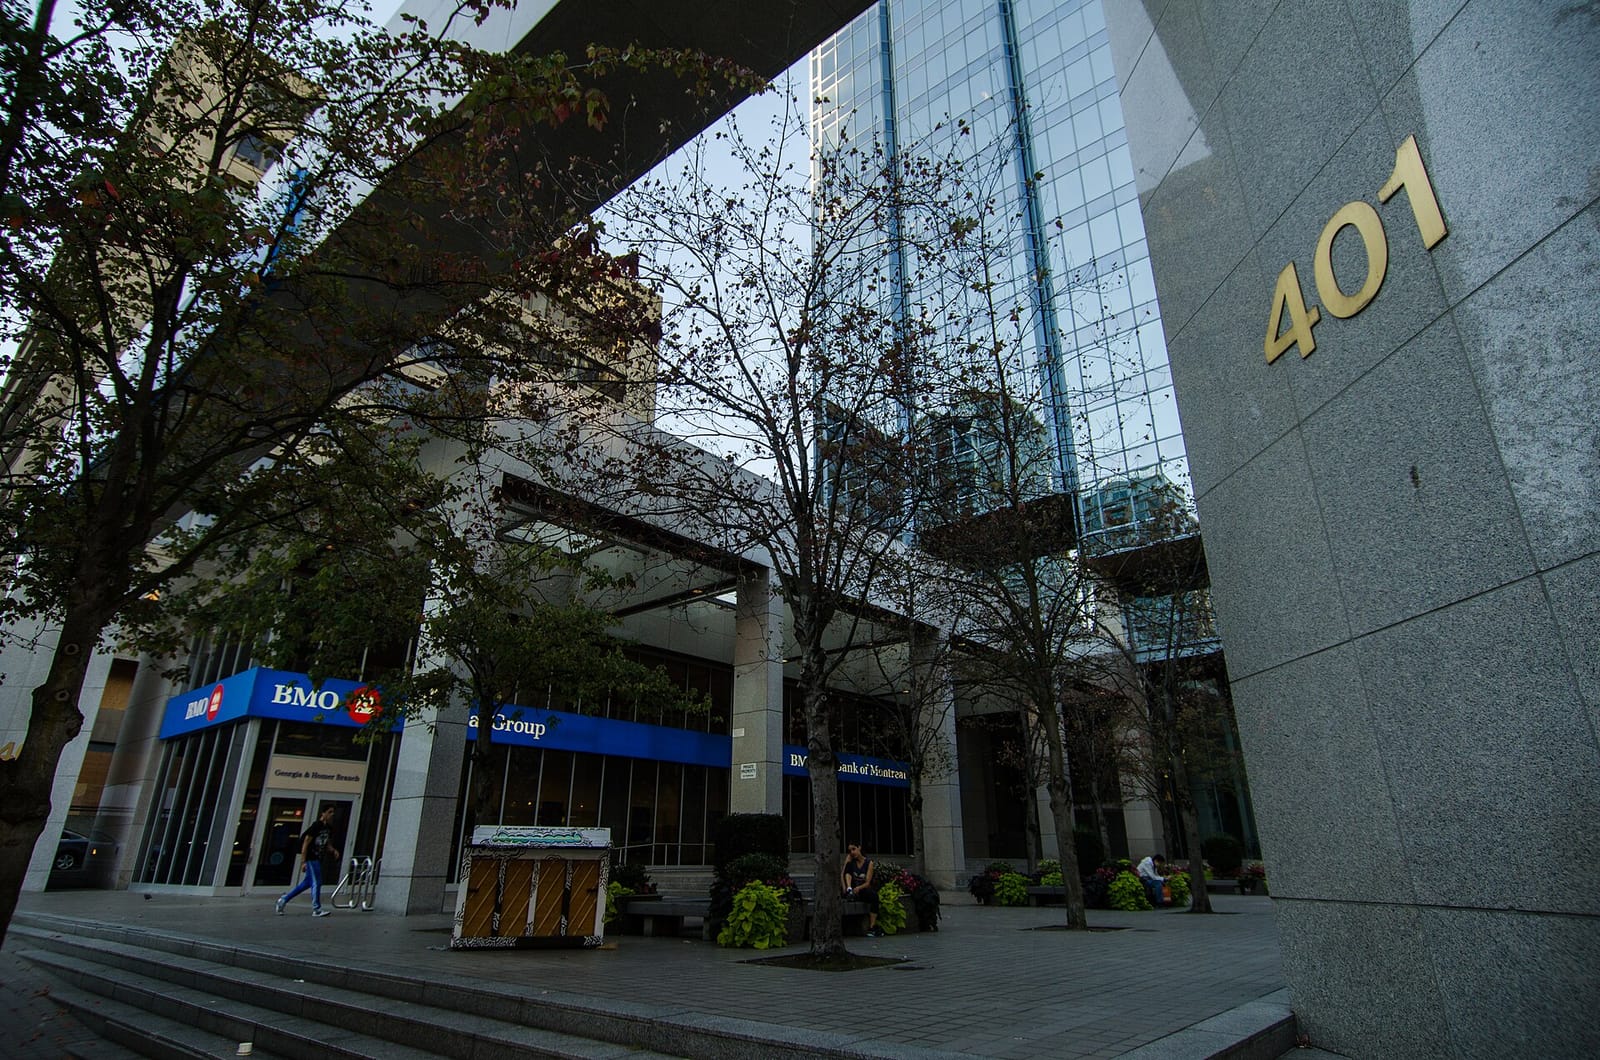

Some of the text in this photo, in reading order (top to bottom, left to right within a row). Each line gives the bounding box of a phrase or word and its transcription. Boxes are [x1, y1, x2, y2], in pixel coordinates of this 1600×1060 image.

[1264, 134, 1448, 366] 401
[184, 697, 209, 720] BMO
[271, 684, 340, 711] BMO
[491, 713, 546, 740] Group
[274, 769, 302, 779] Georgia
[311, 771, 335, 780] Homer
[335, 773, 360, 782] Branch
[789, 753, 809, 767] BM
[859, 763, 870, 775] of
